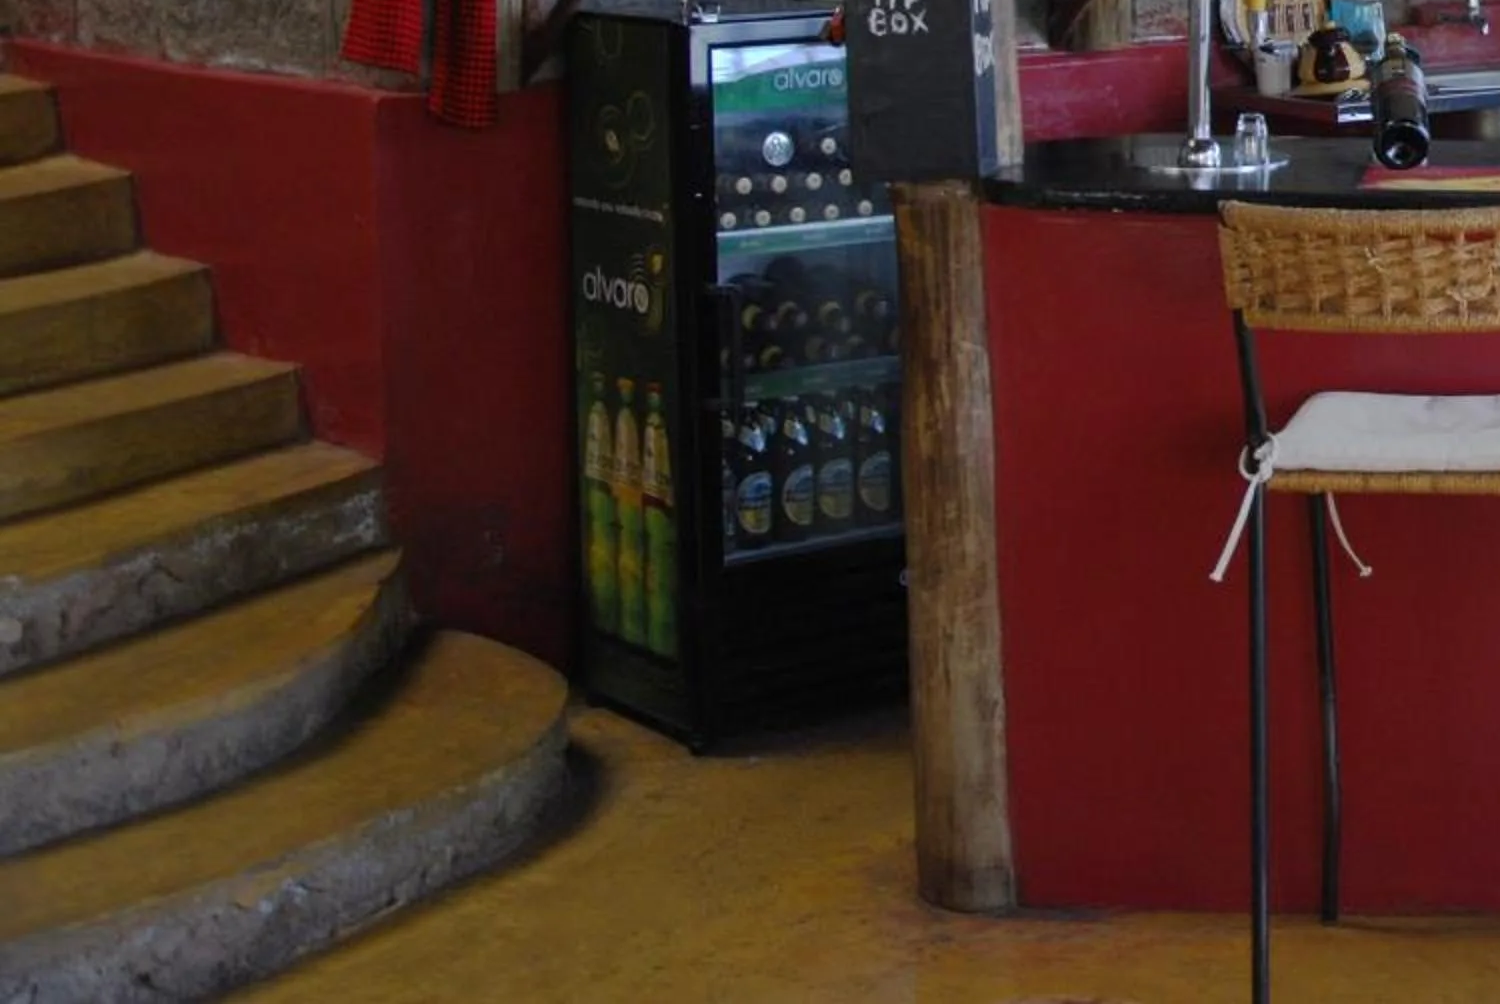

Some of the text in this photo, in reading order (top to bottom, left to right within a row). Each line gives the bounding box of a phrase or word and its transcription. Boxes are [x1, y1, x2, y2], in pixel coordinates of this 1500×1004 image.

[867, 8, 929, 36] BOX
[773, 67, 843, 91] alvaro
[583, 264, 649, 314] alvaro
